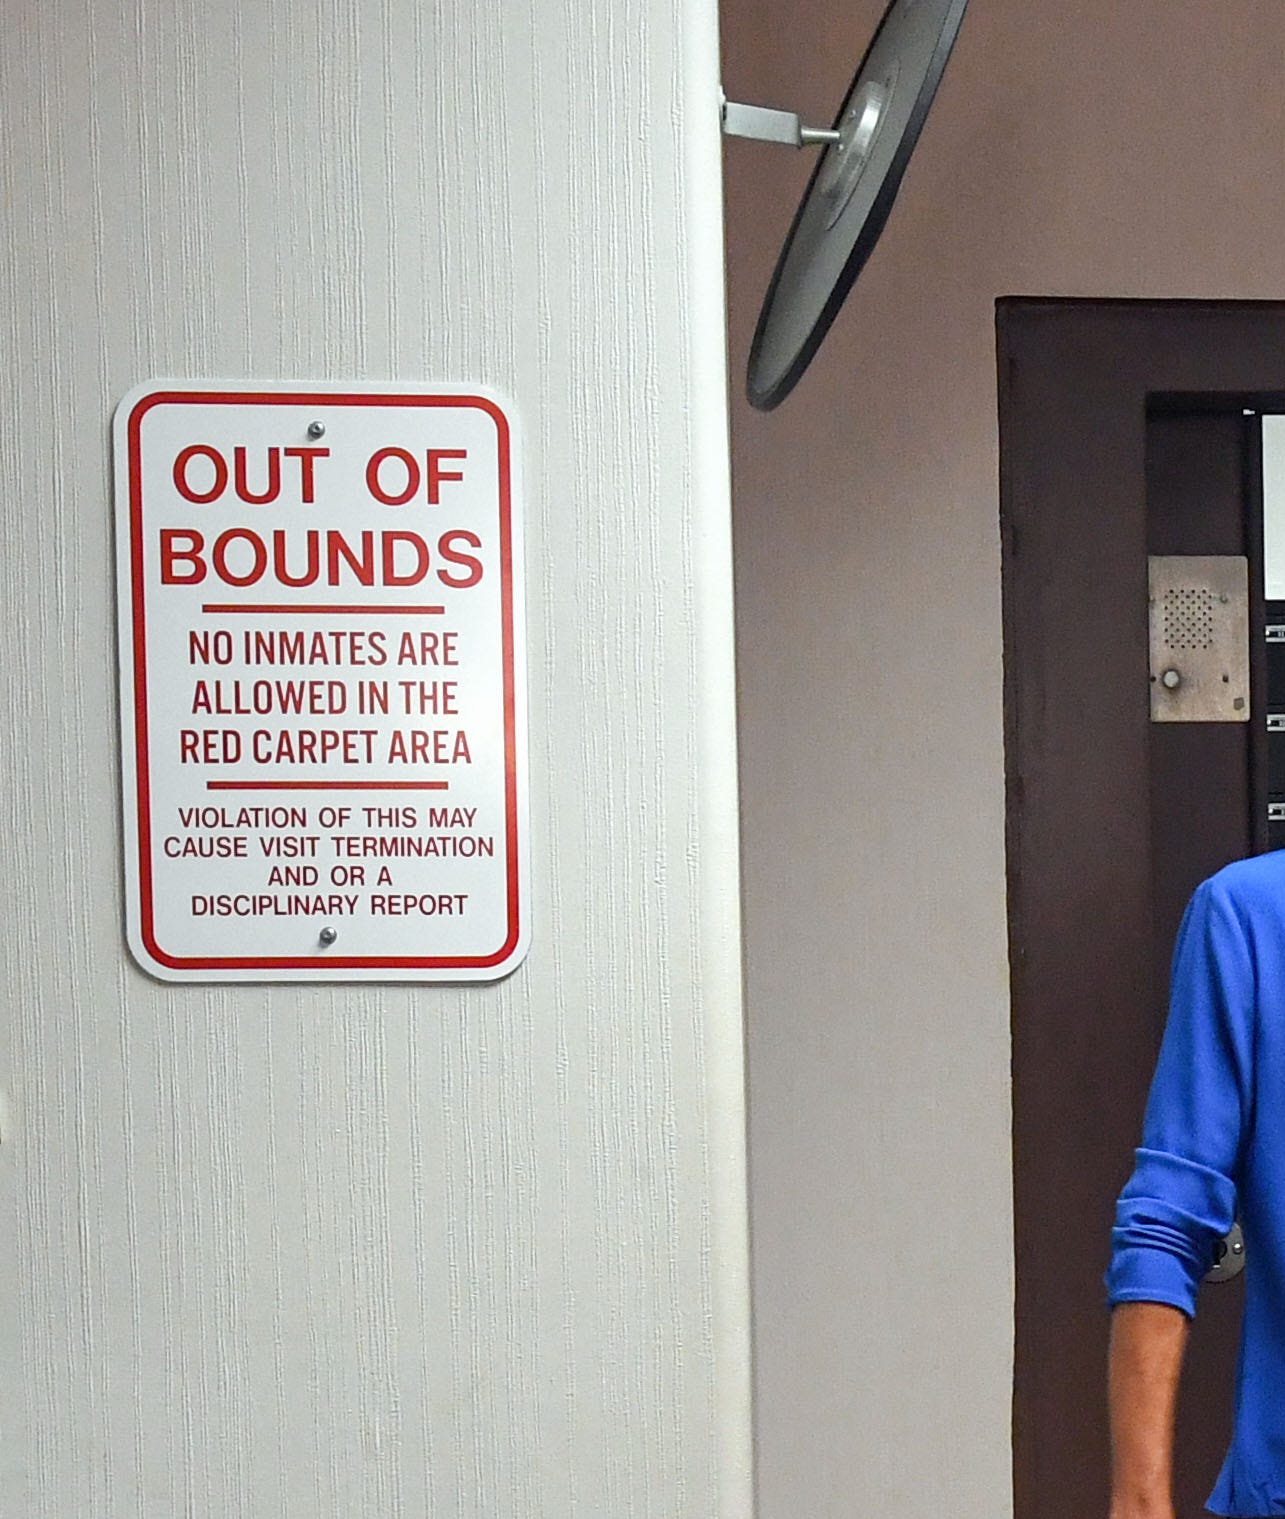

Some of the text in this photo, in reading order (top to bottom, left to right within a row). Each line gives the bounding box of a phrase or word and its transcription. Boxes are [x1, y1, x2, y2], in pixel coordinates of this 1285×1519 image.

[172, 444, 467, 506] OUT OF
[159, 527, 483, 588] BOUNDS
[189, 630, 458, 665] NO INMATES ARE
[191, 679, 458, 714] ALLOWED IN THE
[180, 729, 471, 763] RED CARPET AREA
[177, 806, 476, 828] VIOLATION OF THIS MAY
[163, 836, 493, 857] CAUSE VISIT TERMINATION
[267, 865, 392, 886] AND OR A
[191, 894, 468, 916] DISCIPLINARY REPORT
